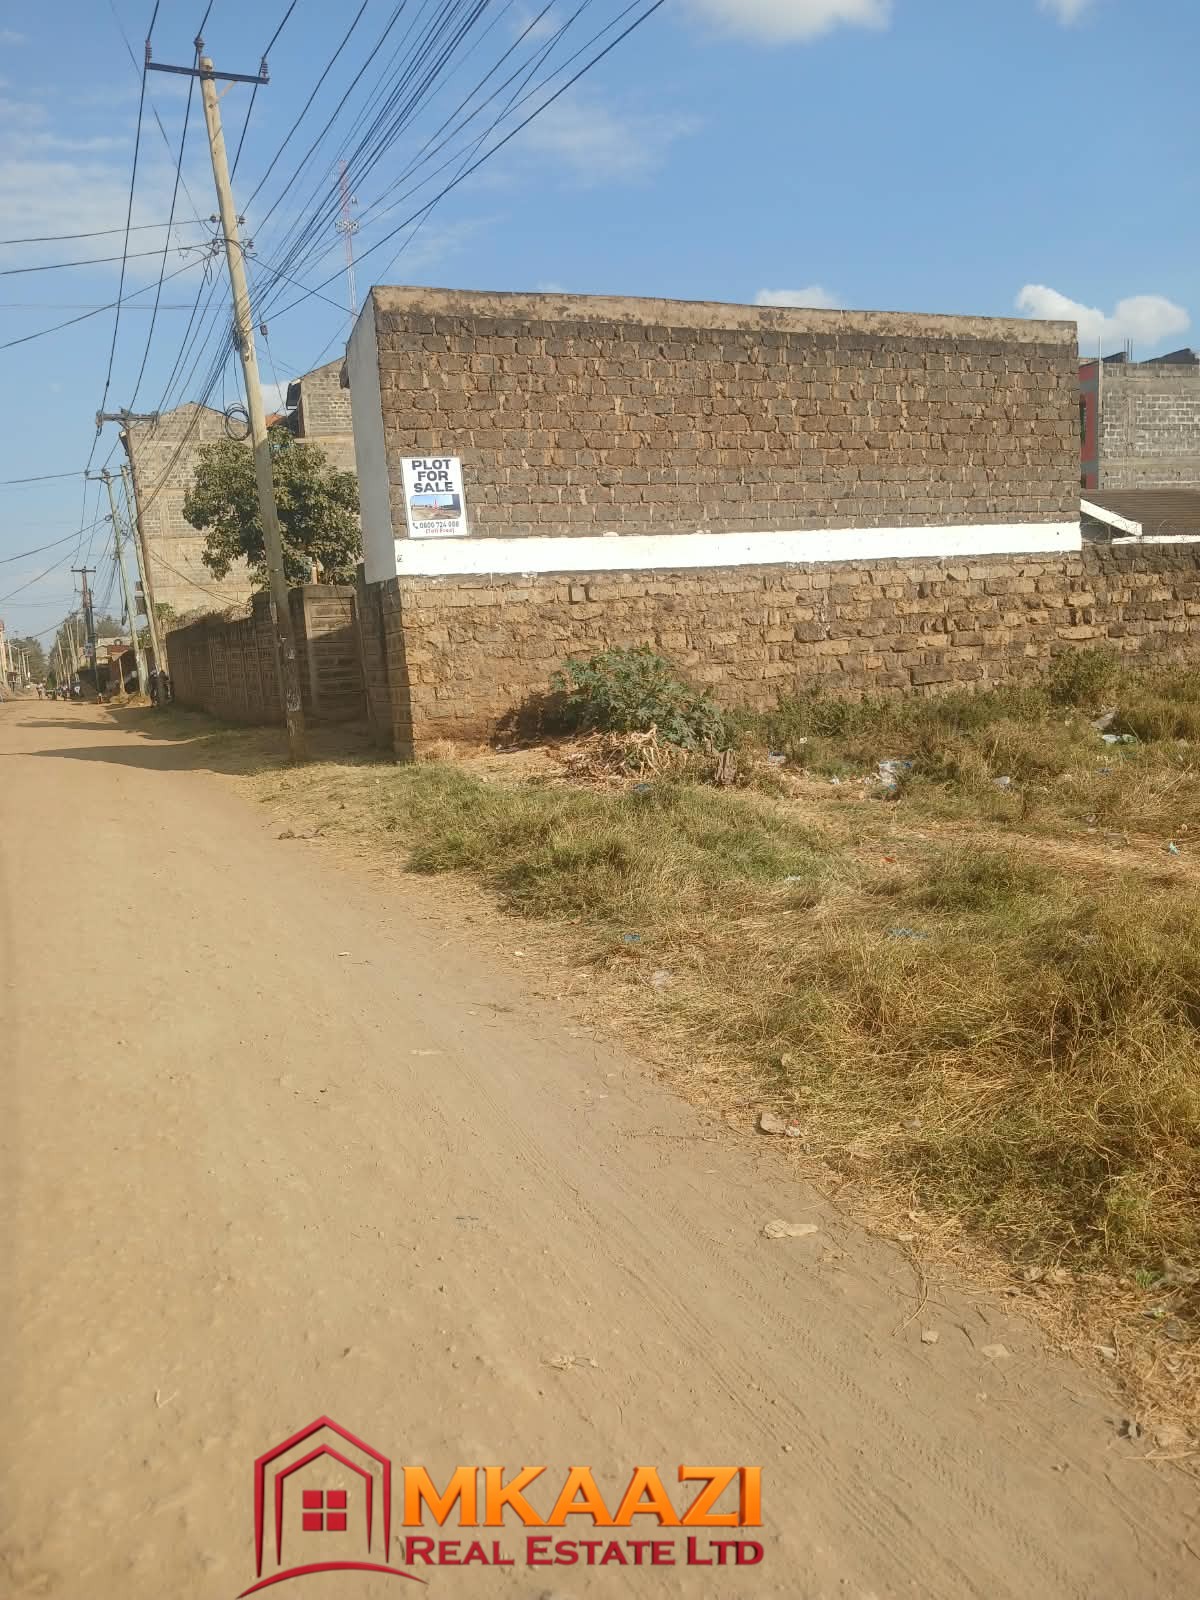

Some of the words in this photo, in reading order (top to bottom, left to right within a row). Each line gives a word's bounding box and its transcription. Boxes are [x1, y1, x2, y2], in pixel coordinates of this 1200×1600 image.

[411, 459, 451, 470] PLOT
[417, 470, 449, 481] FOR
[413, 481, 455, 493] SALE
